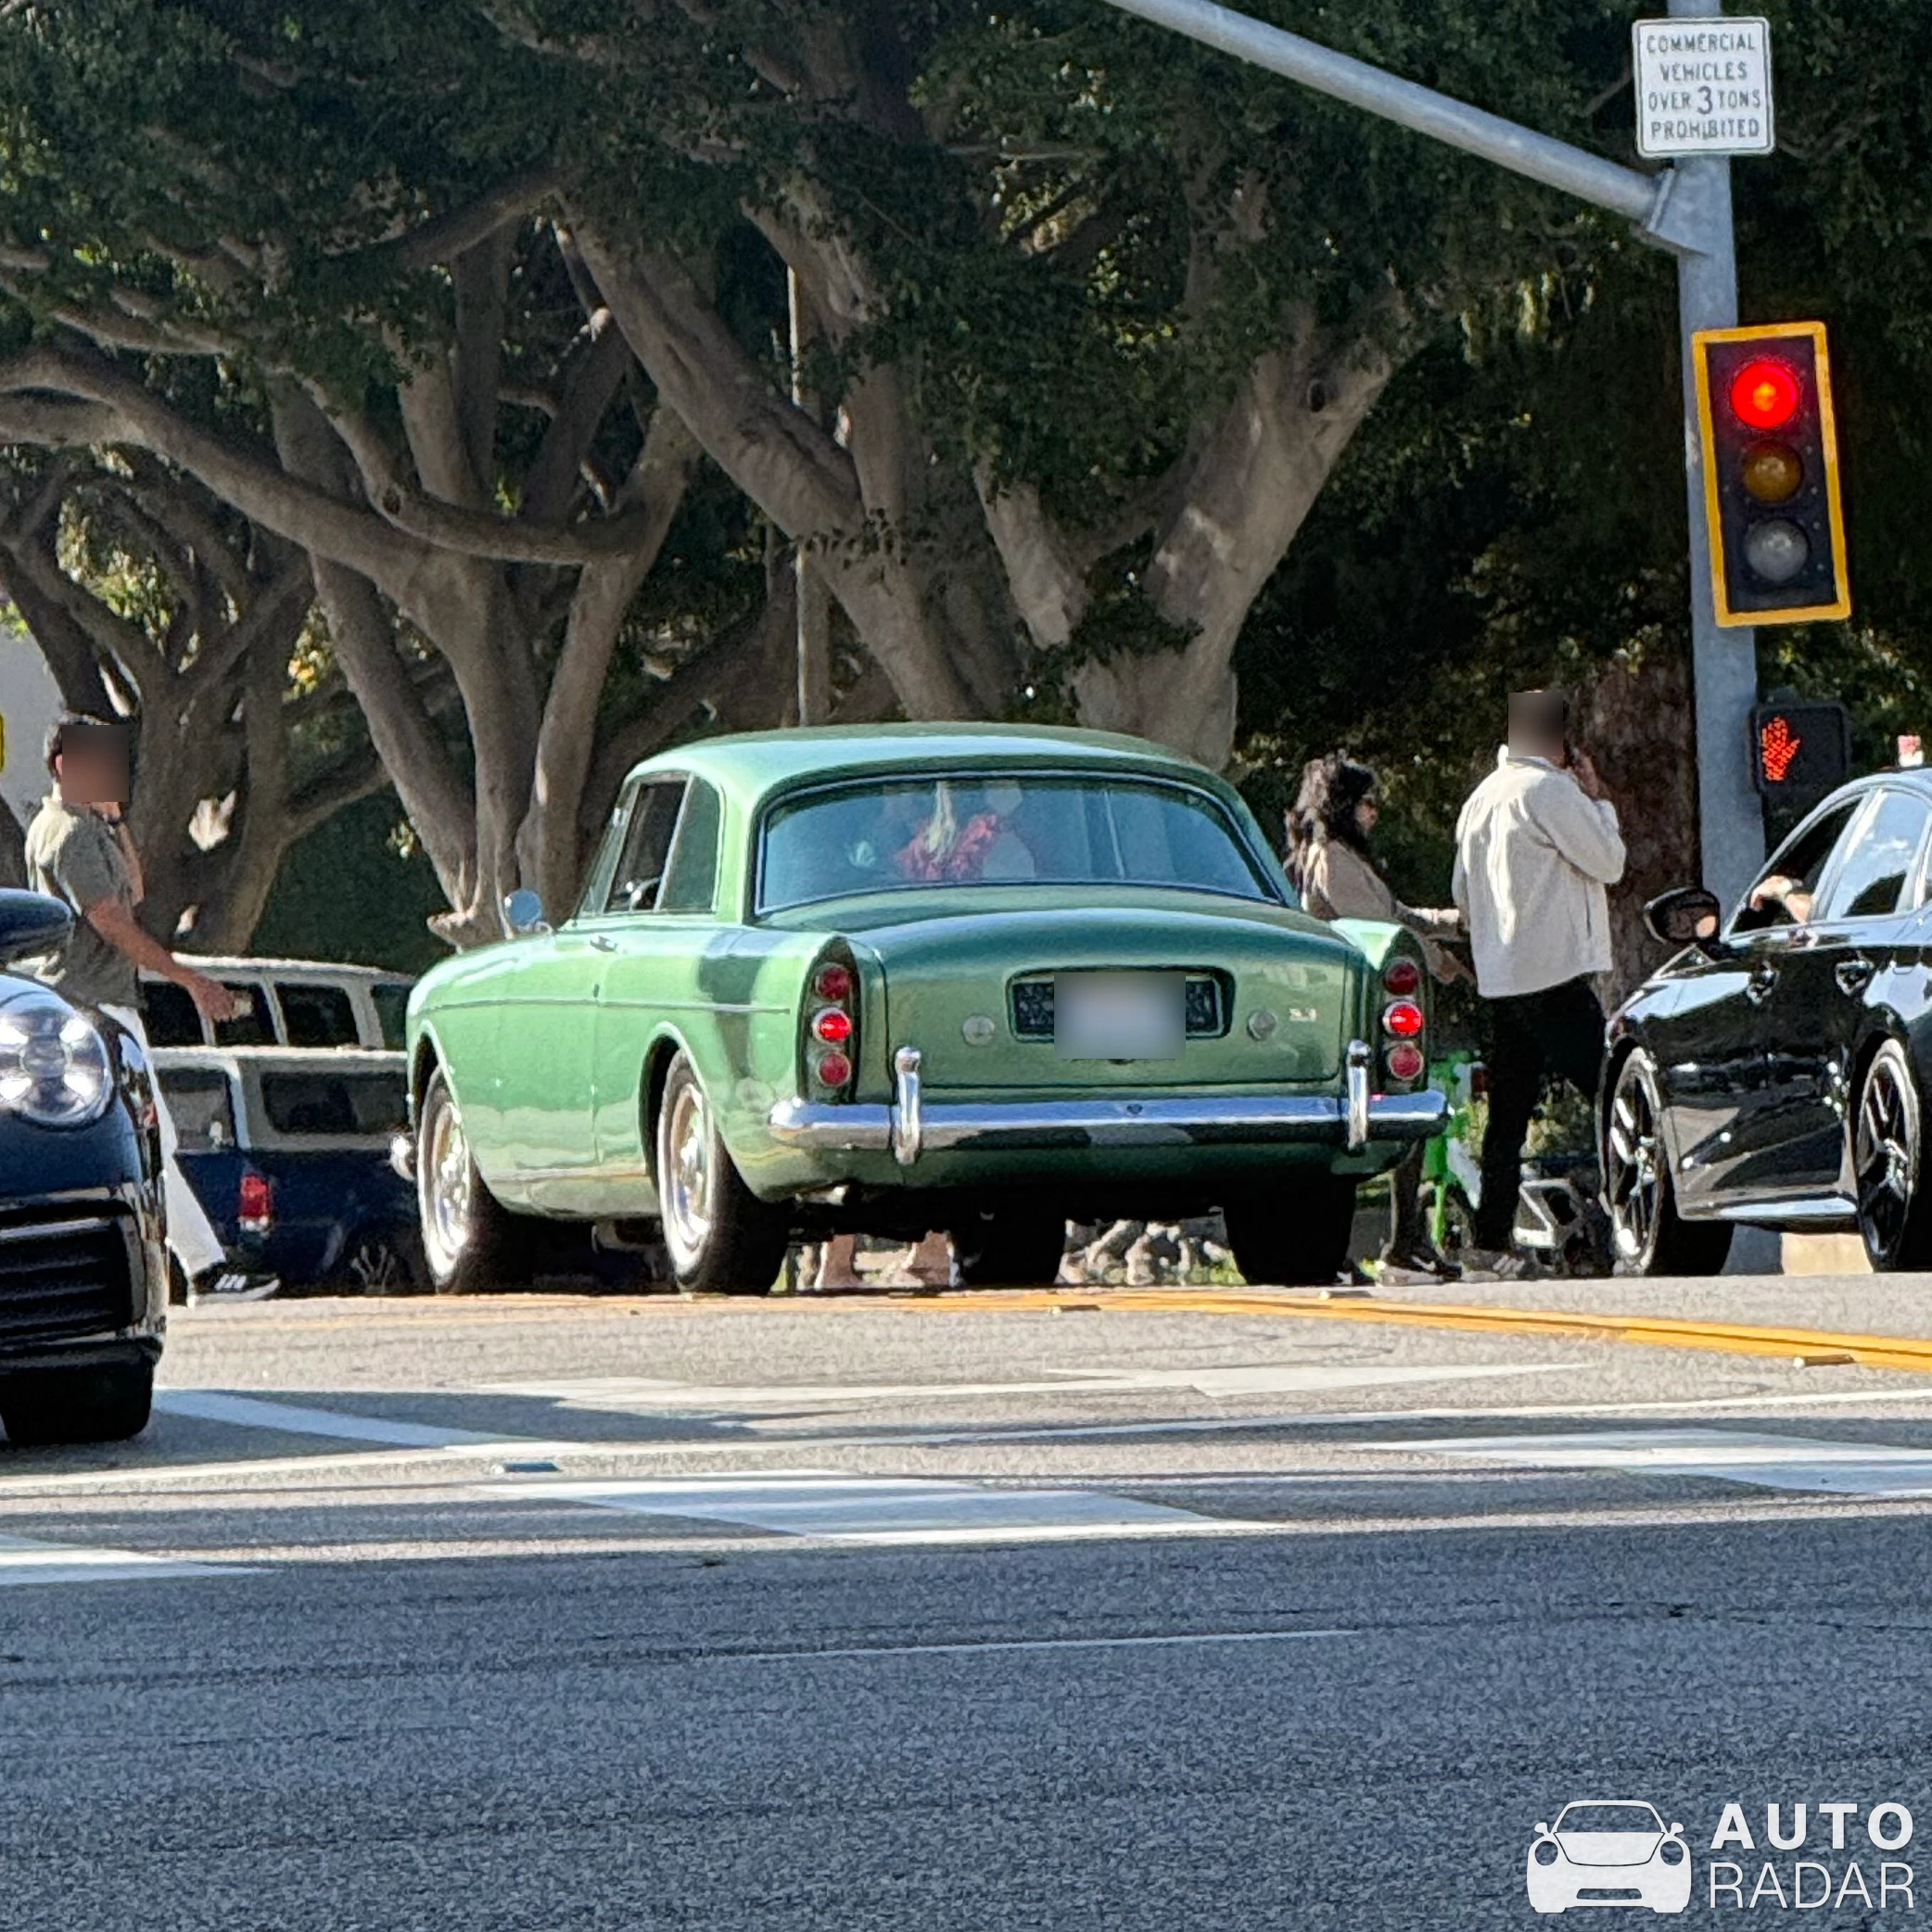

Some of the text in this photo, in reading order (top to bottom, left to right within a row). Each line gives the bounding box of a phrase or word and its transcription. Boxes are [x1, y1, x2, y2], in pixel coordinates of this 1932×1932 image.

[1646, 33, 1756, 53] COMMERCIAL
[1660, 61, 1748, 82] VEHICLES
[1648, 85, 1760, 115] OVER 3 TONS
[1651, 118, 1760, 140] PROHIBITED
